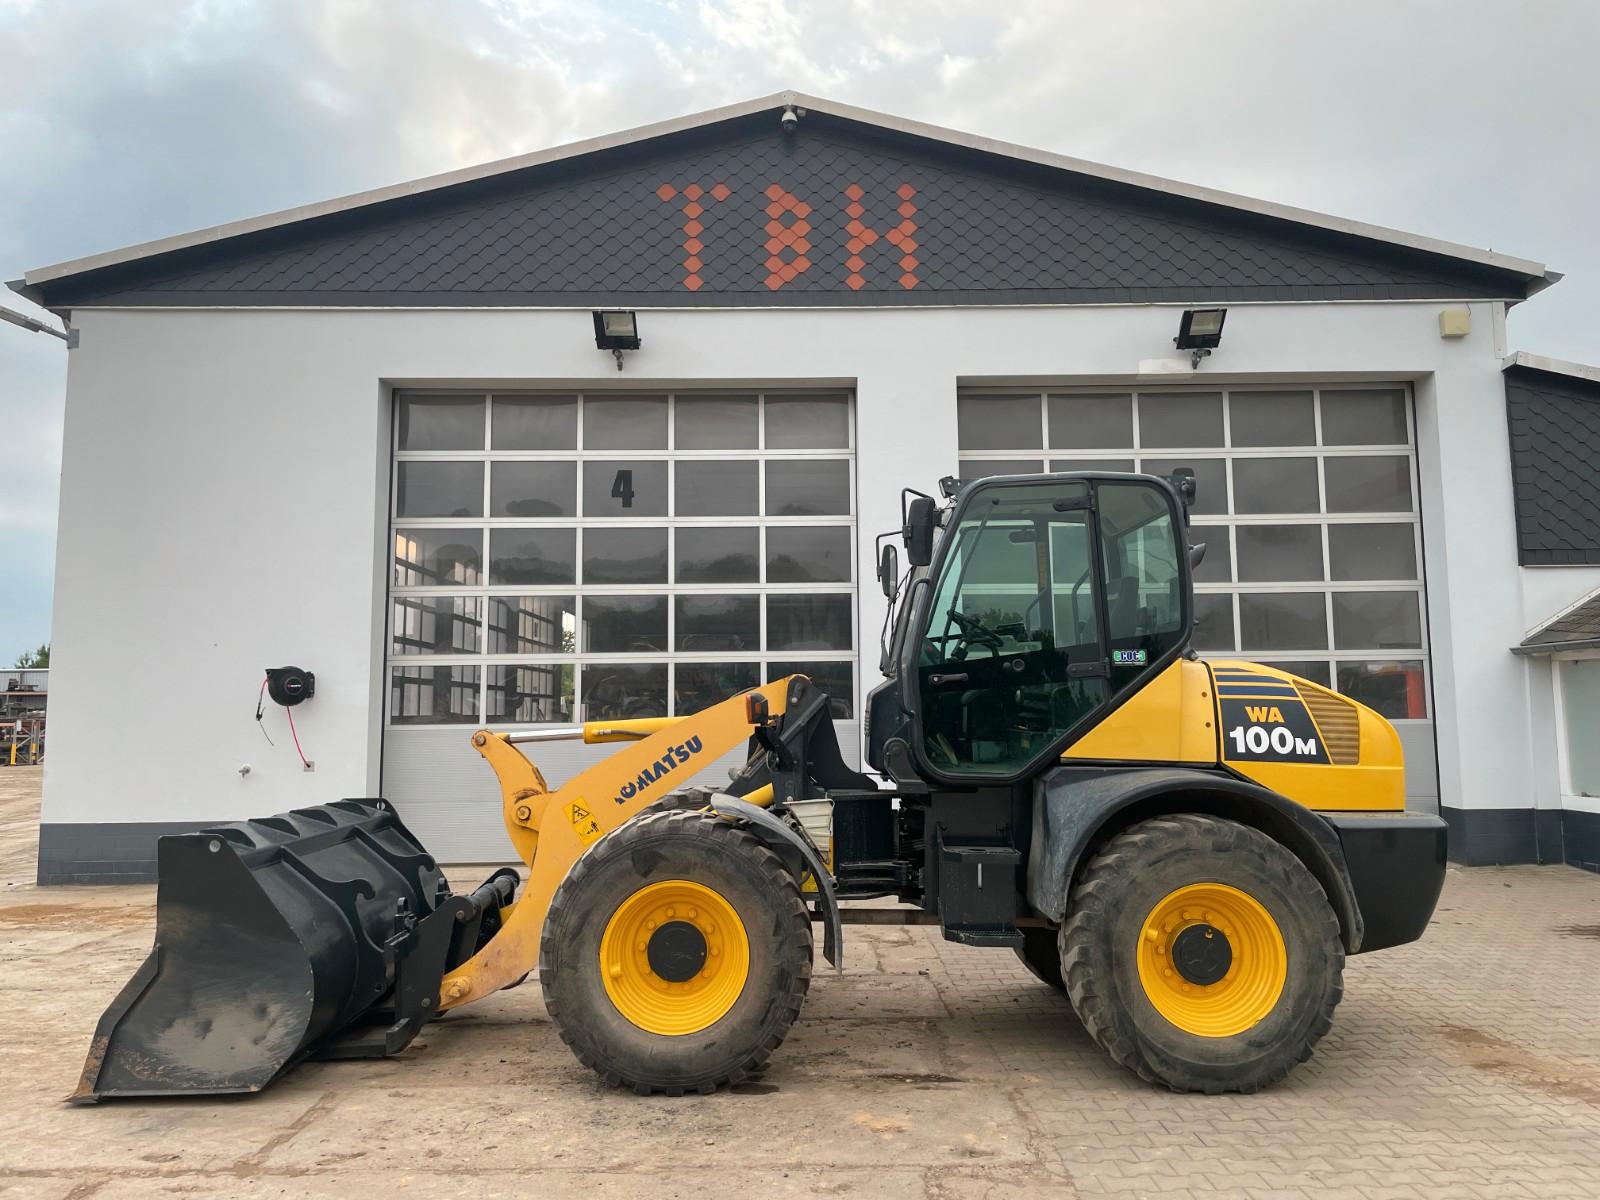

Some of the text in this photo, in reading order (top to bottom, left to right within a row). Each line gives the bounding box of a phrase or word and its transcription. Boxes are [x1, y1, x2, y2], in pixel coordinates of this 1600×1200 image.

[655, 183, 919, 291] TBH
[611, 470, 634, 508] 4
[1245, 706, 1285, 723] WA
[1229, 725, 1317, 756] 100M
